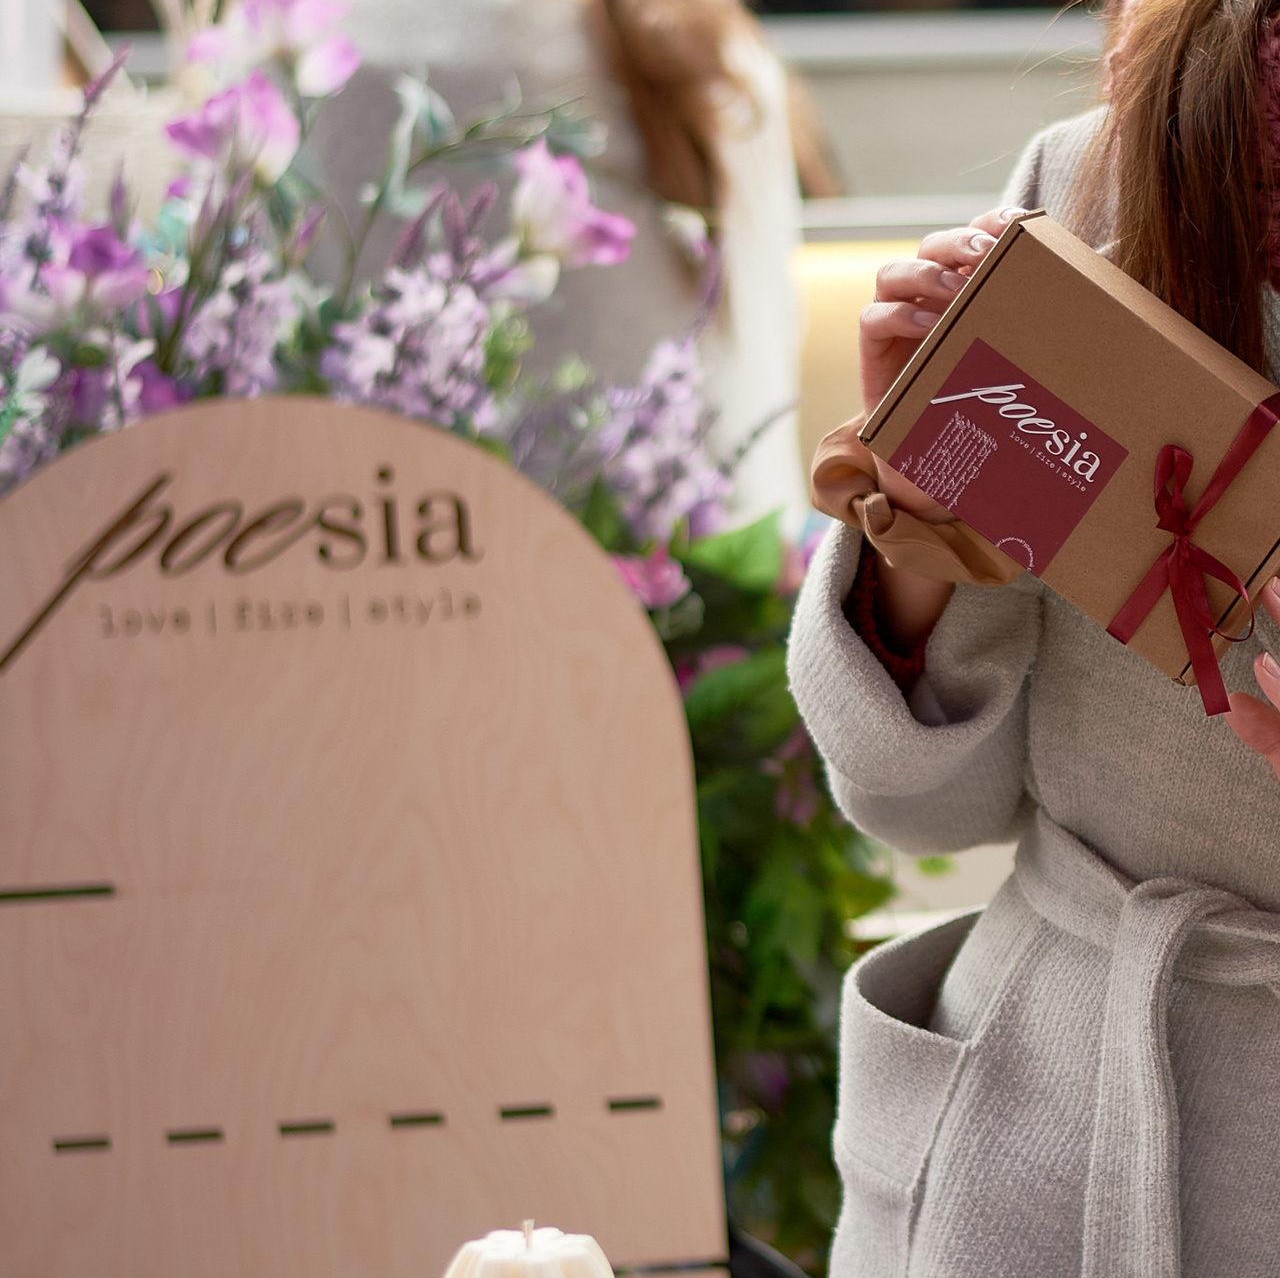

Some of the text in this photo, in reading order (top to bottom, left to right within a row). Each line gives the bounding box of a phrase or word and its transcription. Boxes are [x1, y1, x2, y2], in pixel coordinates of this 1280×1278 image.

[930, 383, 1101, 483] poesia
[1009, 430, 1087, 493] love fire style
[0, 461, 485, 675] poesia
[99, 587, 483, 640] love fire style
